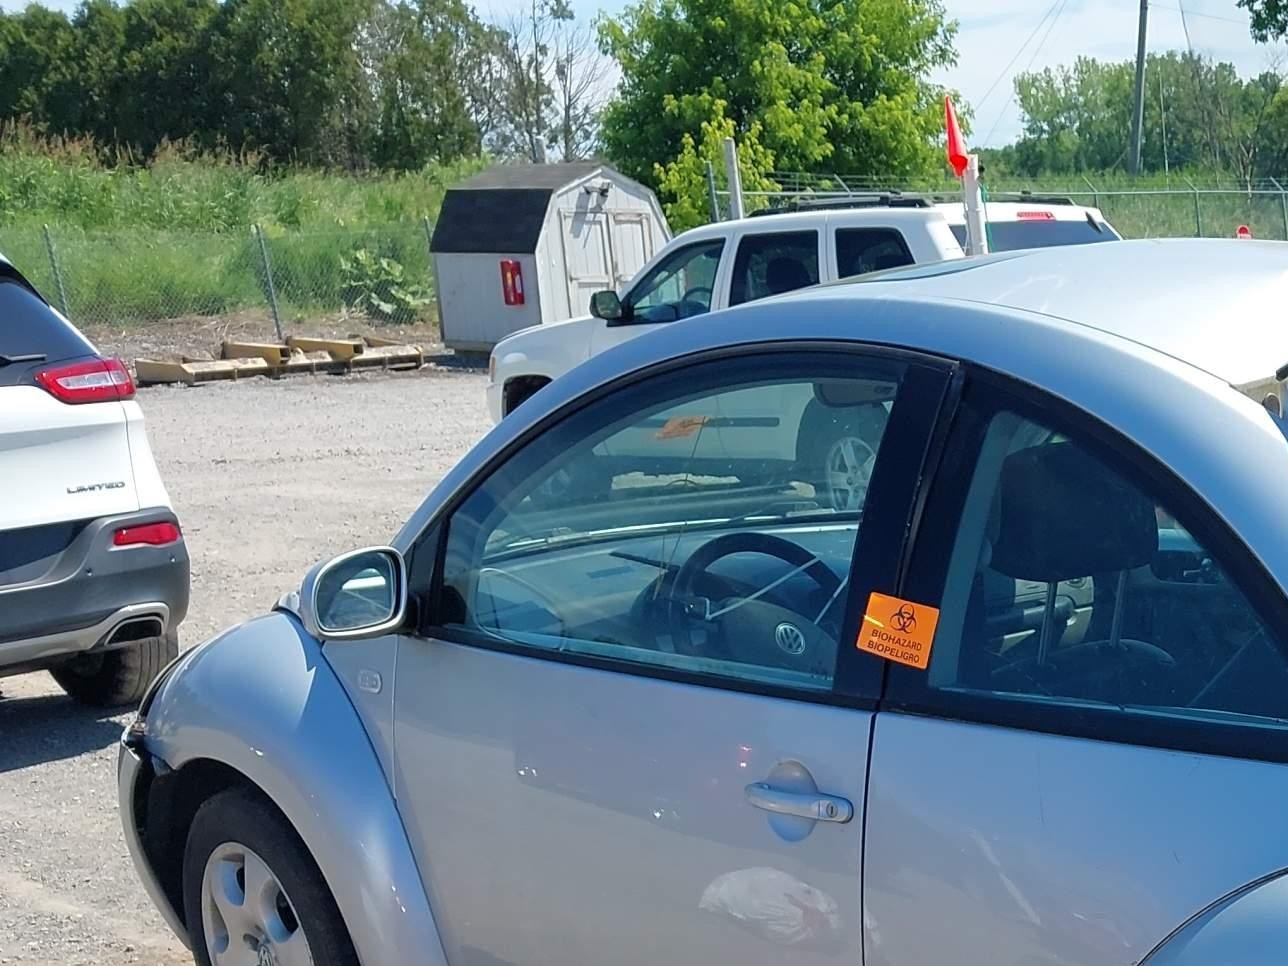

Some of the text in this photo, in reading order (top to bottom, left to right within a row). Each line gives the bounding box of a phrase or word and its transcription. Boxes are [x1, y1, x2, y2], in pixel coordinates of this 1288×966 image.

[66, 481, 125, 494] LIMITED
[775, 623, 805, 654] VW
[871, 629, 922, 651] BIOHAZARD
[867, 640, 920, 664] BIOPELIGRO
